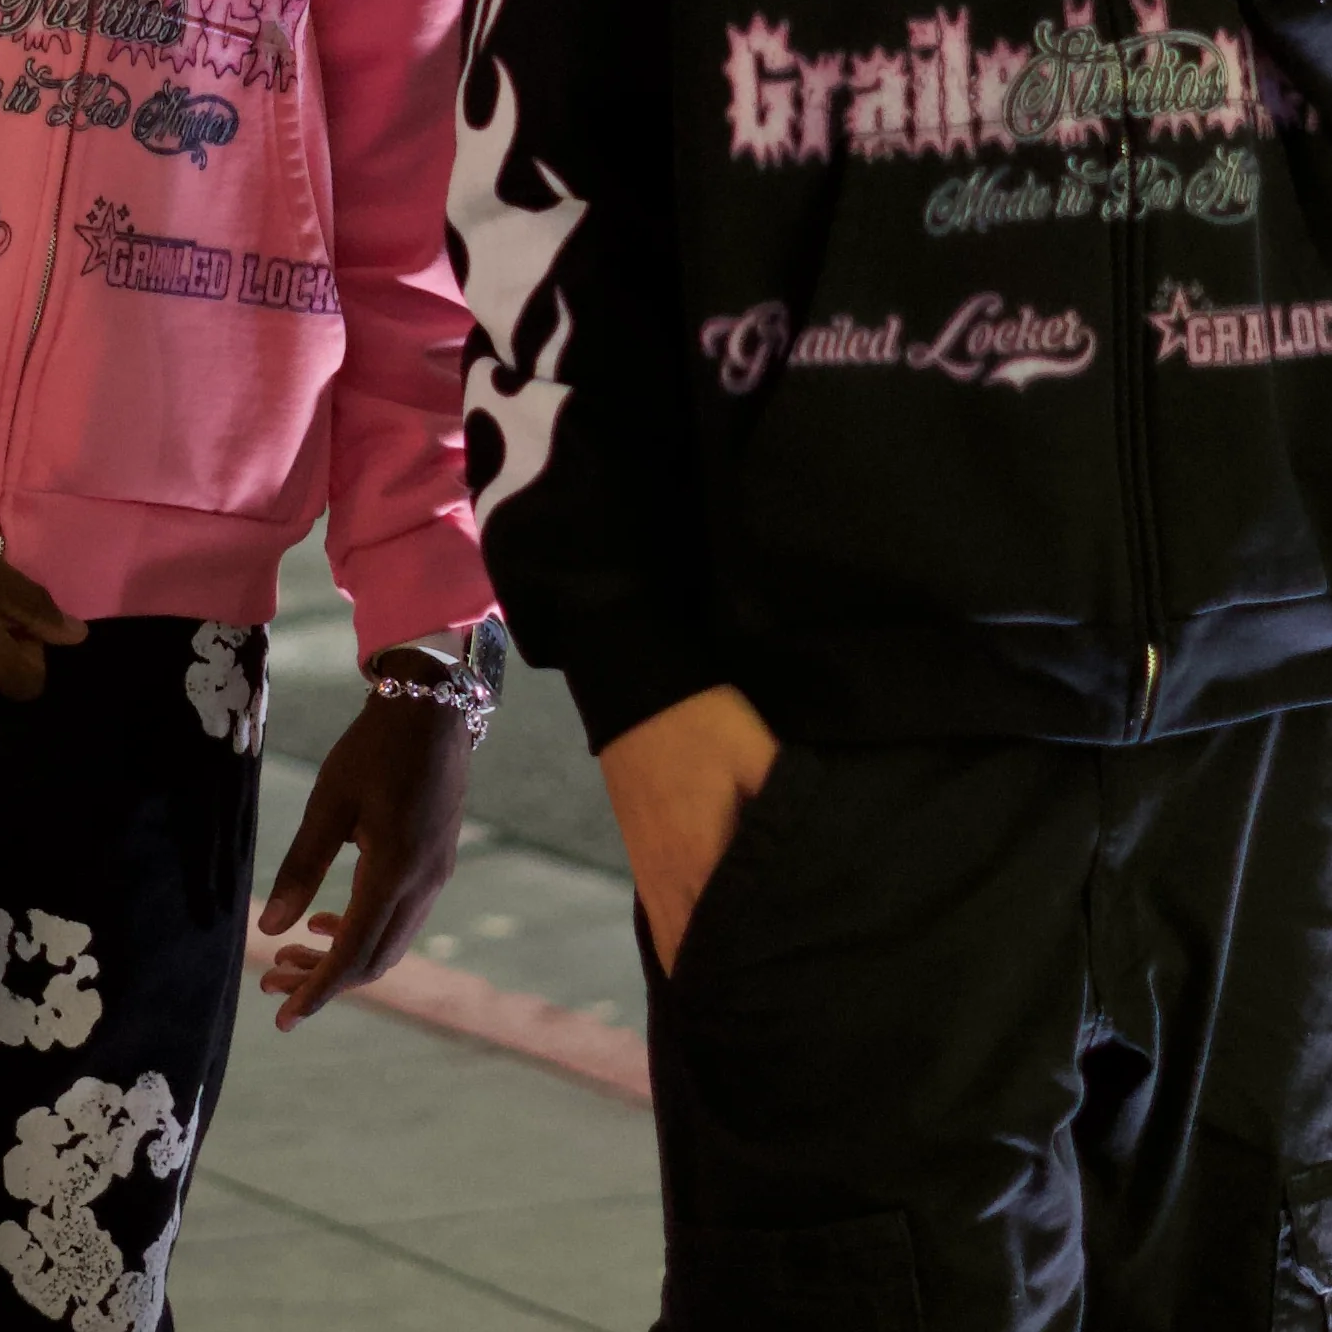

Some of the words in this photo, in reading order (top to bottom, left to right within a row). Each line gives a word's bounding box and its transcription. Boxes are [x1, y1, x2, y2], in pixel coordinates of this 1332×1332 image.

[3, 75, 41, 114] in
[25, 57, 130, 131] Los
[923, 165, 1052, 236] Made
[237, 253, 343, 314] LOCK
[701, 298, 904, 395] Gailed
[907, 291, 1097, 392] Locker
